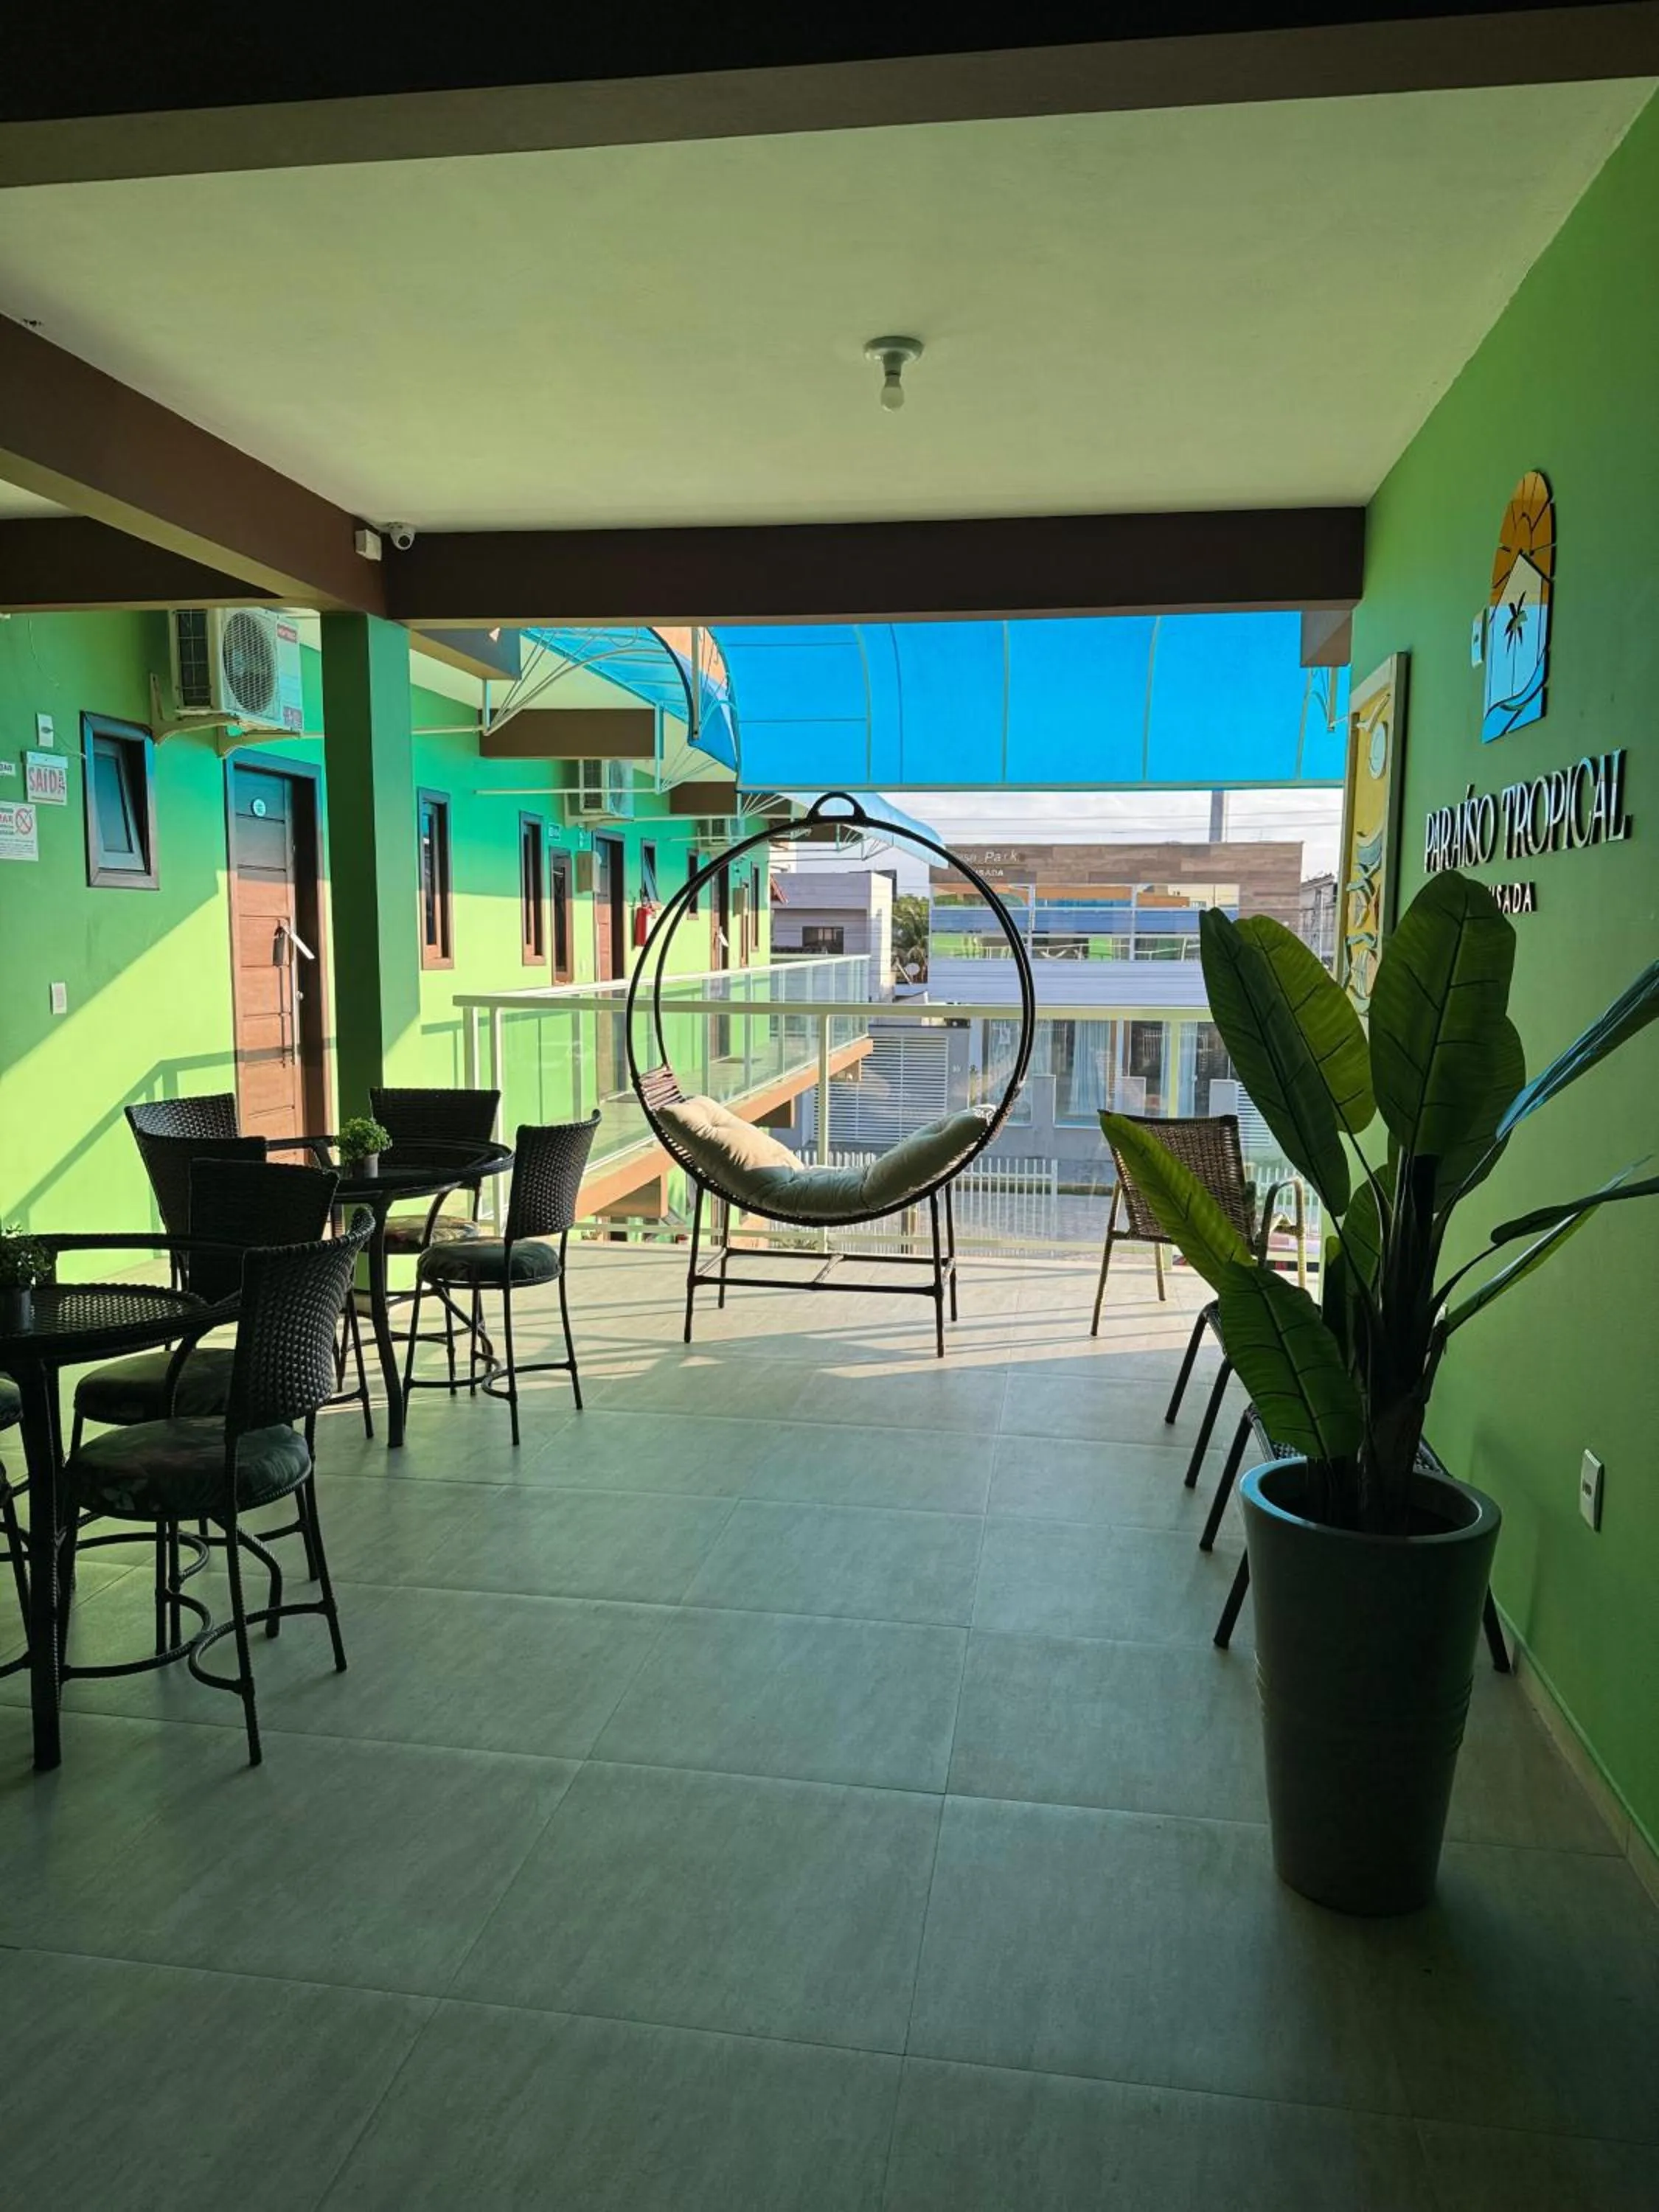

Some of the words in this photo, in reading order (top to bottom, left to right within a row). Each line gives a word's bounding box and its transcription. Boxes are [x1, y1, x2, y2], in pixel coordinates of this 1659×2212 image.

[1424, 785, 1496, 873] PARAÍSO
[1500, 748, 1627, 860] TROPICAL
[985, 849, 1018, 863] Park
[1488, 880, 1534, 915] SADA
